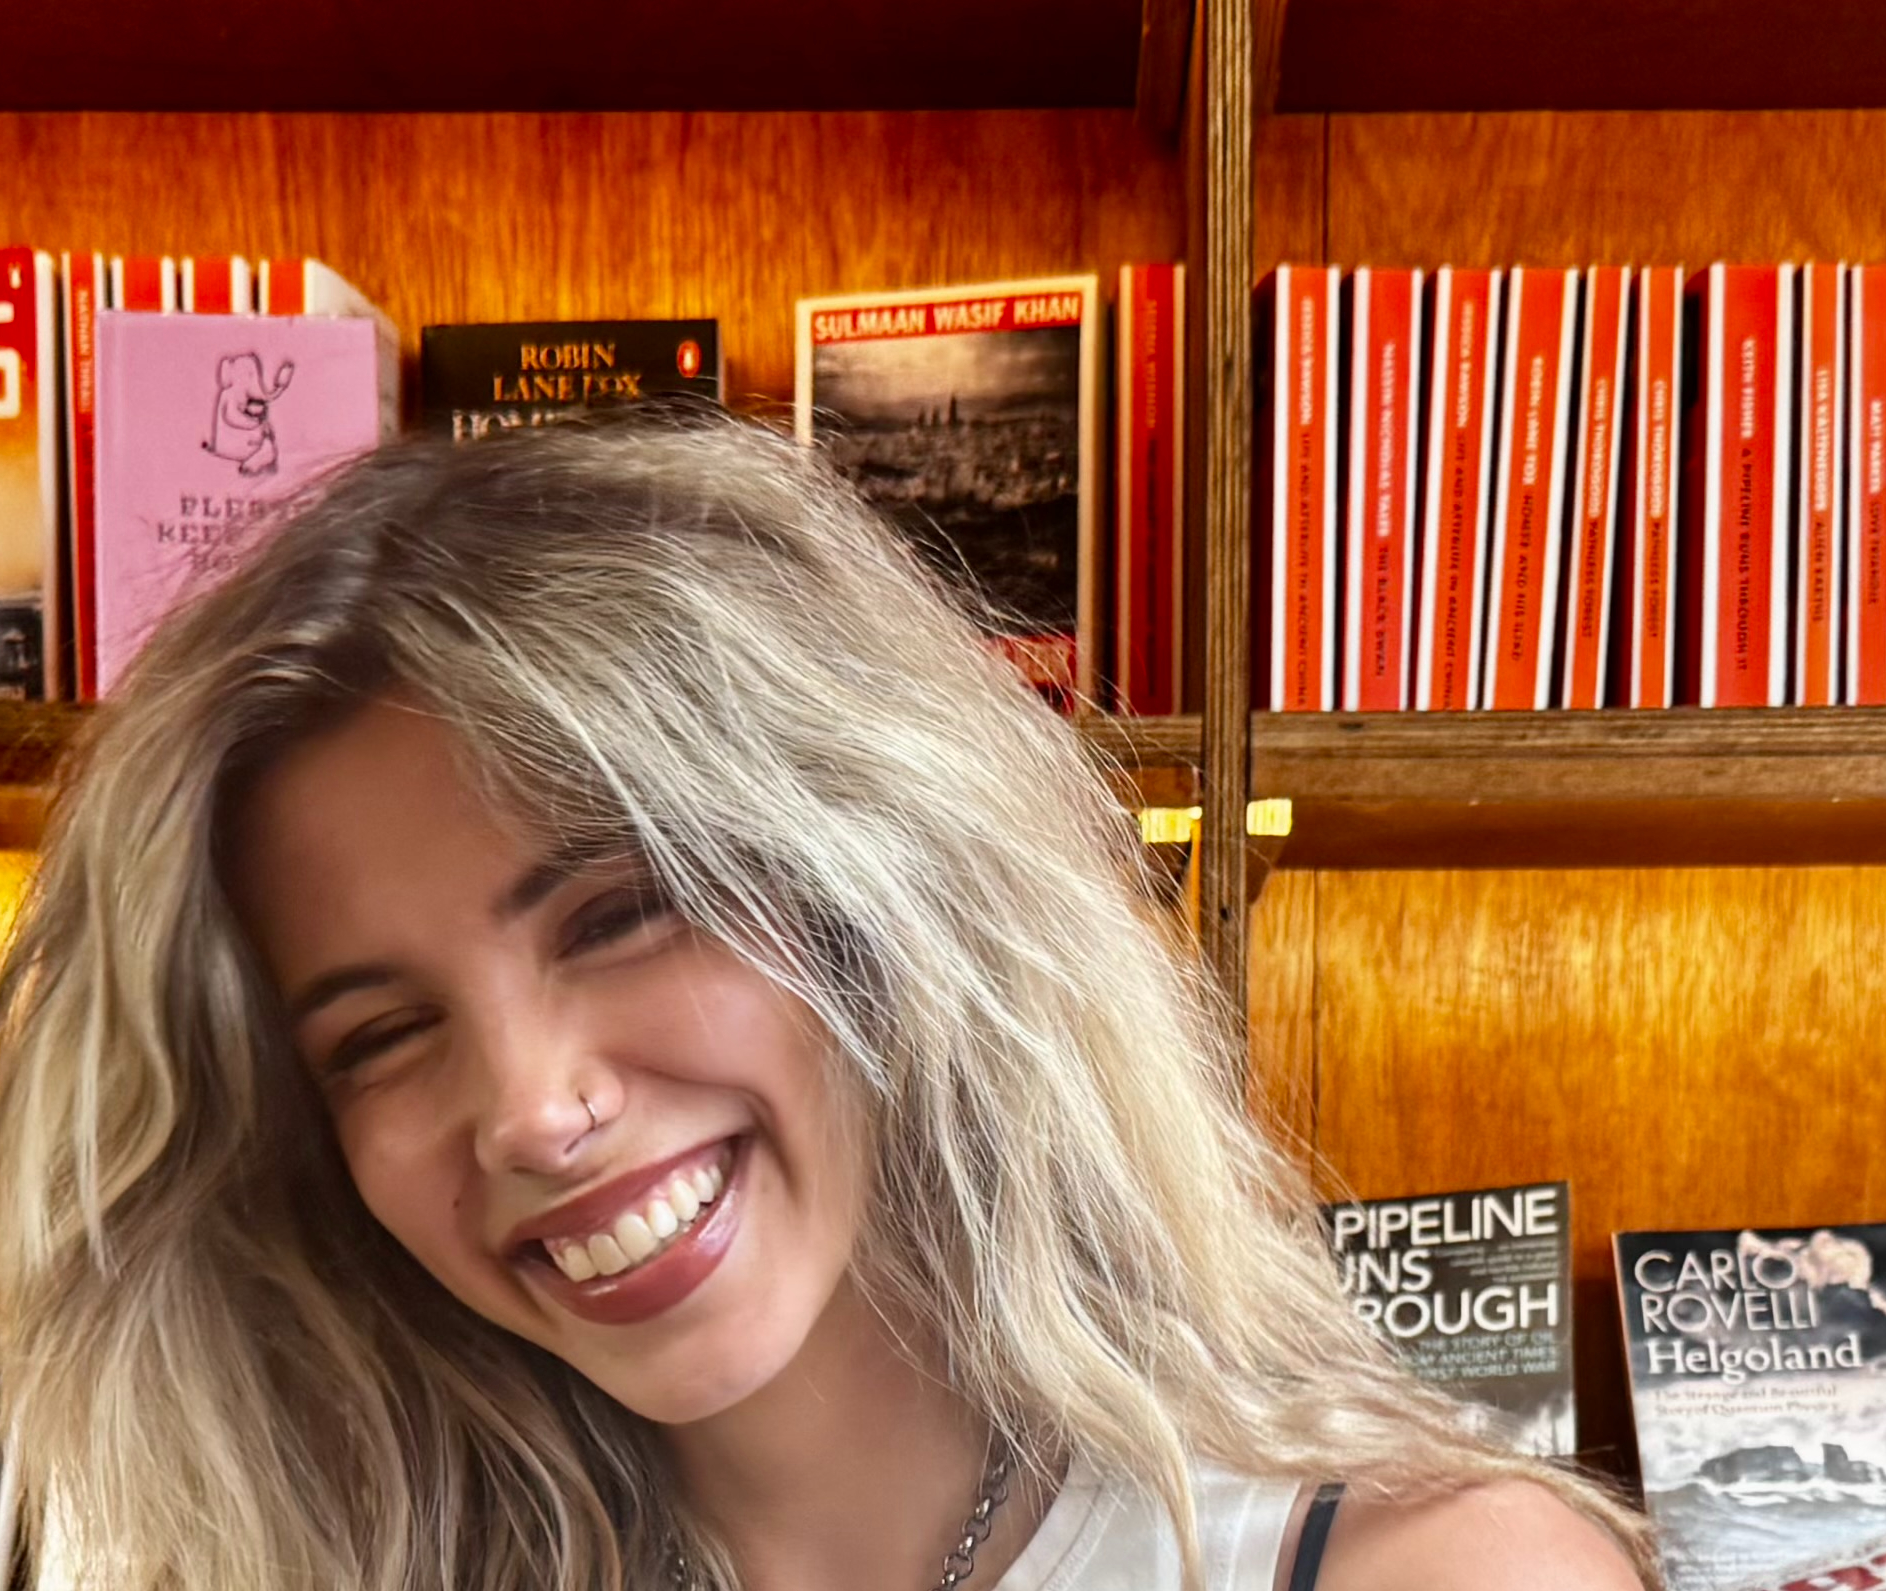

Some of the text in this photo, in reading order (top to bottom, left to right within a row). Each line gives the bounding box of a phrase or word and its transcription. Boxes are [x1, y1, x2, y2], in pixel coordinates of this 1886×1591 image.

[815, 296, 1079, 340] SULMAAN WASIF KHAN
[520, 343, 616, 370] ROBIN
[493, 374, 573, 402] LANE
[1333, 1188, 1559, 1251] PIPELINE
[1338, 1248, 1434, 1295] UNS
[1634, 1249, 1797, 1294] CARLO
[1353, 1281, 1559, 1338] ROUGH
[1640, 1288, 1820, 1333] ROVELLI
[1435, 1349, 1511, 1365] ANCIENT
[1464, 1363, 1517, 1379] WORLD
[1646, 1330, 1865, 1385] Helgoland
